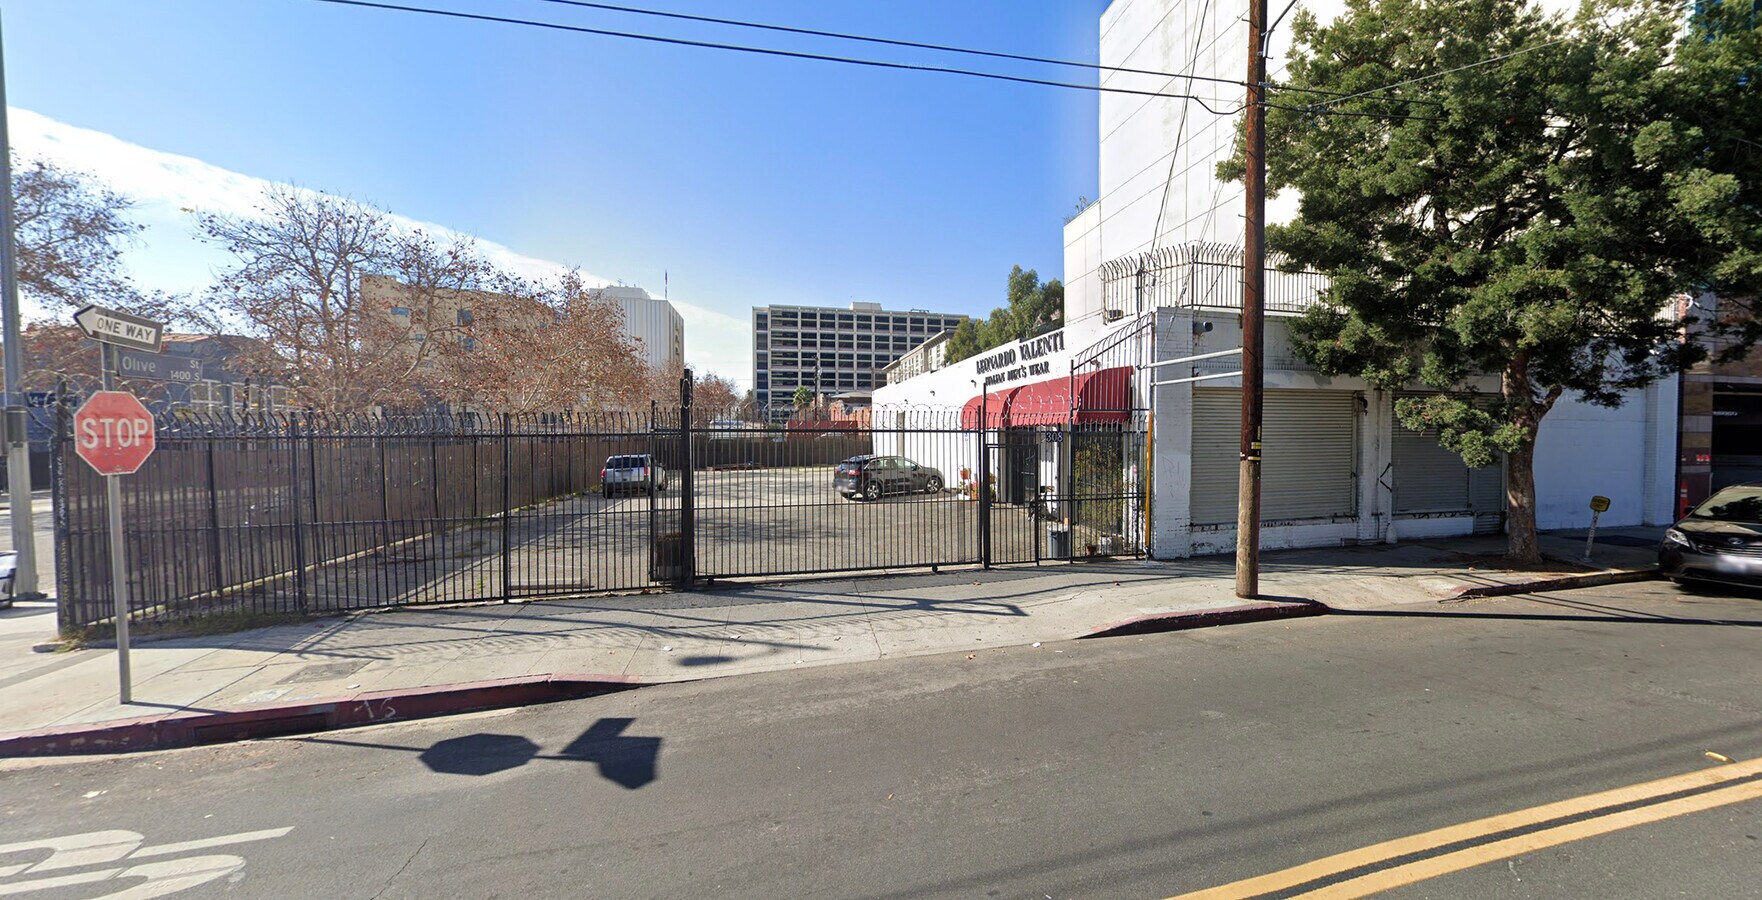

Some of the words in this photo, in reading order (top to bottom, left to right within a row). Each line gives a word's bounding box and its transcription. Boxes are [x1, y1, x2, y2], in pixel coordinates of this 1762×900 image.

[96, 317, 122, 334] ONE
[126, 324, 153, 341] WAY
[976, 349, 1016, 375] LEONARDO
[1019, 331, 1065, 361] VALENTI
[122, 356, 156, 372] Olive
[189, 359, 200, 369] St
[1028, 361, 1050, 376] WEAR
[171, 370, 191, 380] 1400
[81, 418, 149, 449] STOP
[1046, 431, 1064, 442] 308
